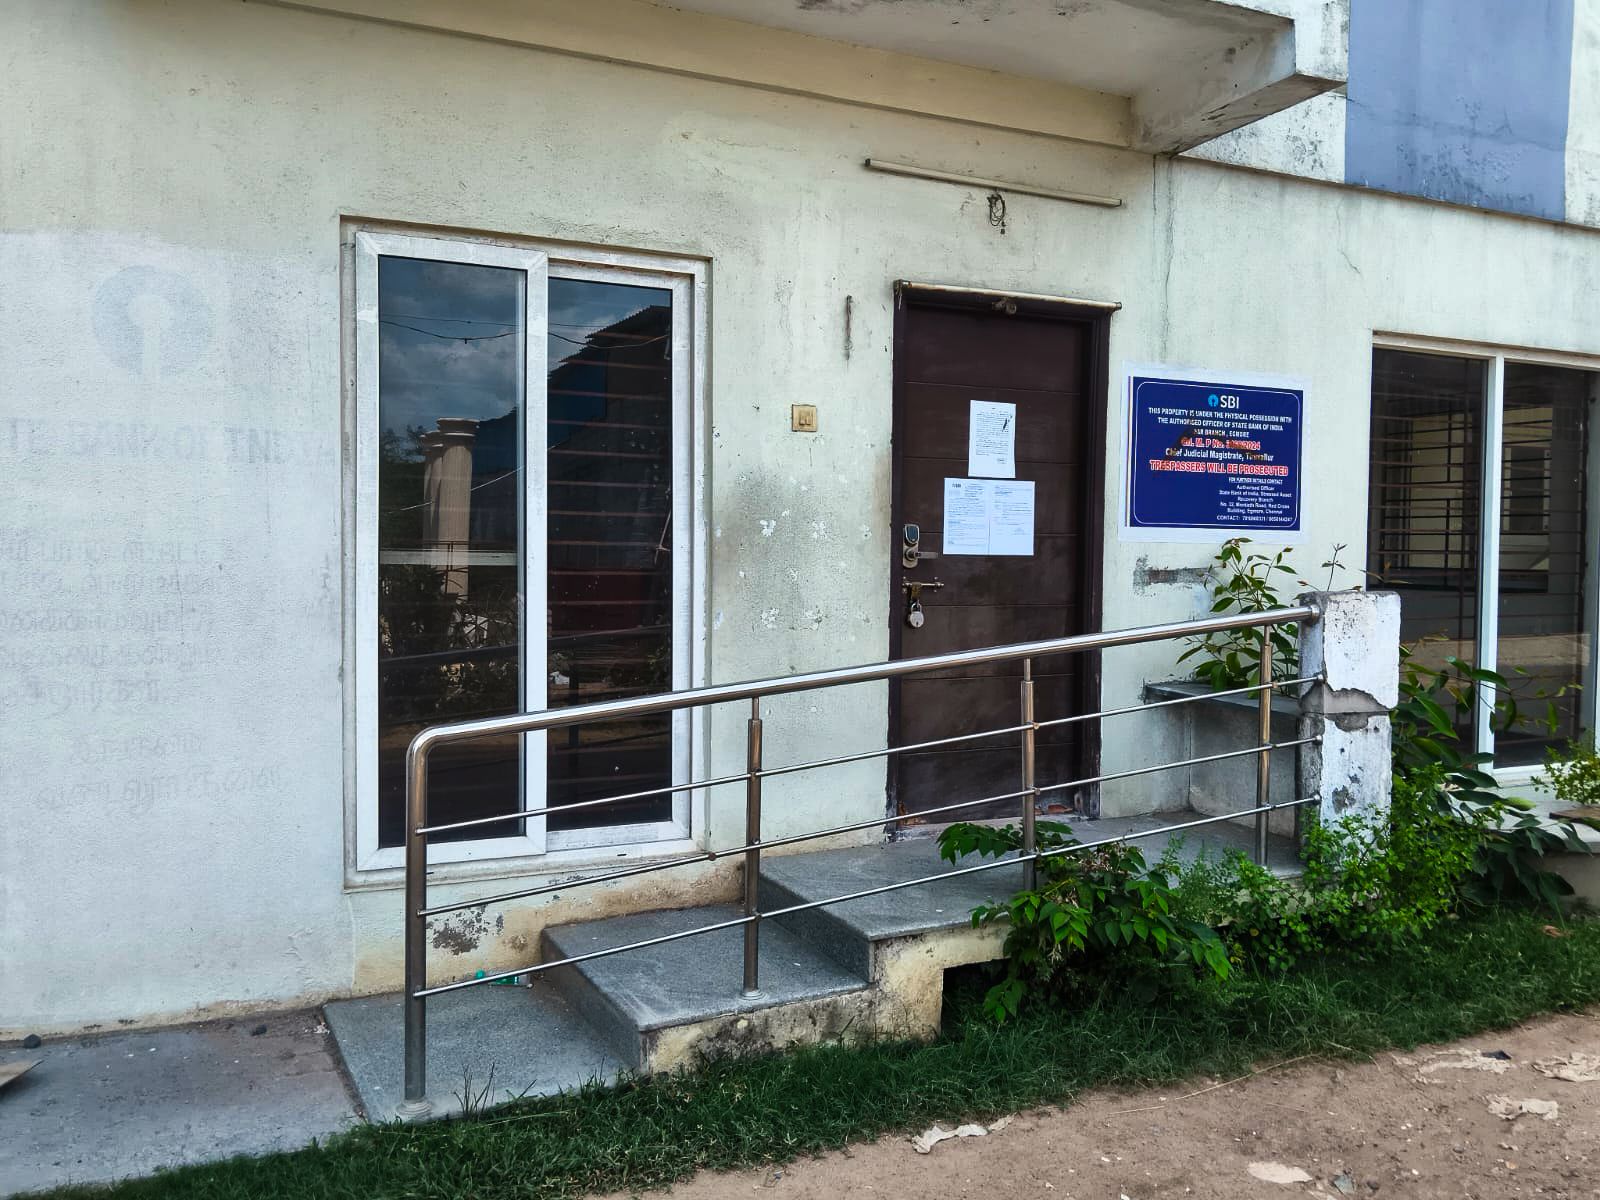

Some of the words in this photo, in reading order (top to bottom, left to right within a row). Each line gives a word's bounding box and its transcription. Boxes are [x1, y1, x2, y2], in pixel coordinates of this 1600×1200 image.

[1220, 395, 1240, 409] SBI
[1161, 408, 1189, 416] PROPERTY
[1195, 410, 1213, 418] UNDER
[1214, 411, 1224, 419] THE
[1224, 412, 1248, 420] PHYSICAL
[1249, 414, 1279, 422] POSSESSION
[1165, 448, 1183, 456] Chief
[1183, 449, 1208, 458] Judicial
[1209, 450, 1244, 461] Magistrate,
[1149, 459, 1206, 473] TRESPASSERS
[1207, 462, 1226, 474] WILL
[1227, 463, 1239, 474] BE
[1239, 463, 1289, 476] PROSECUTED
